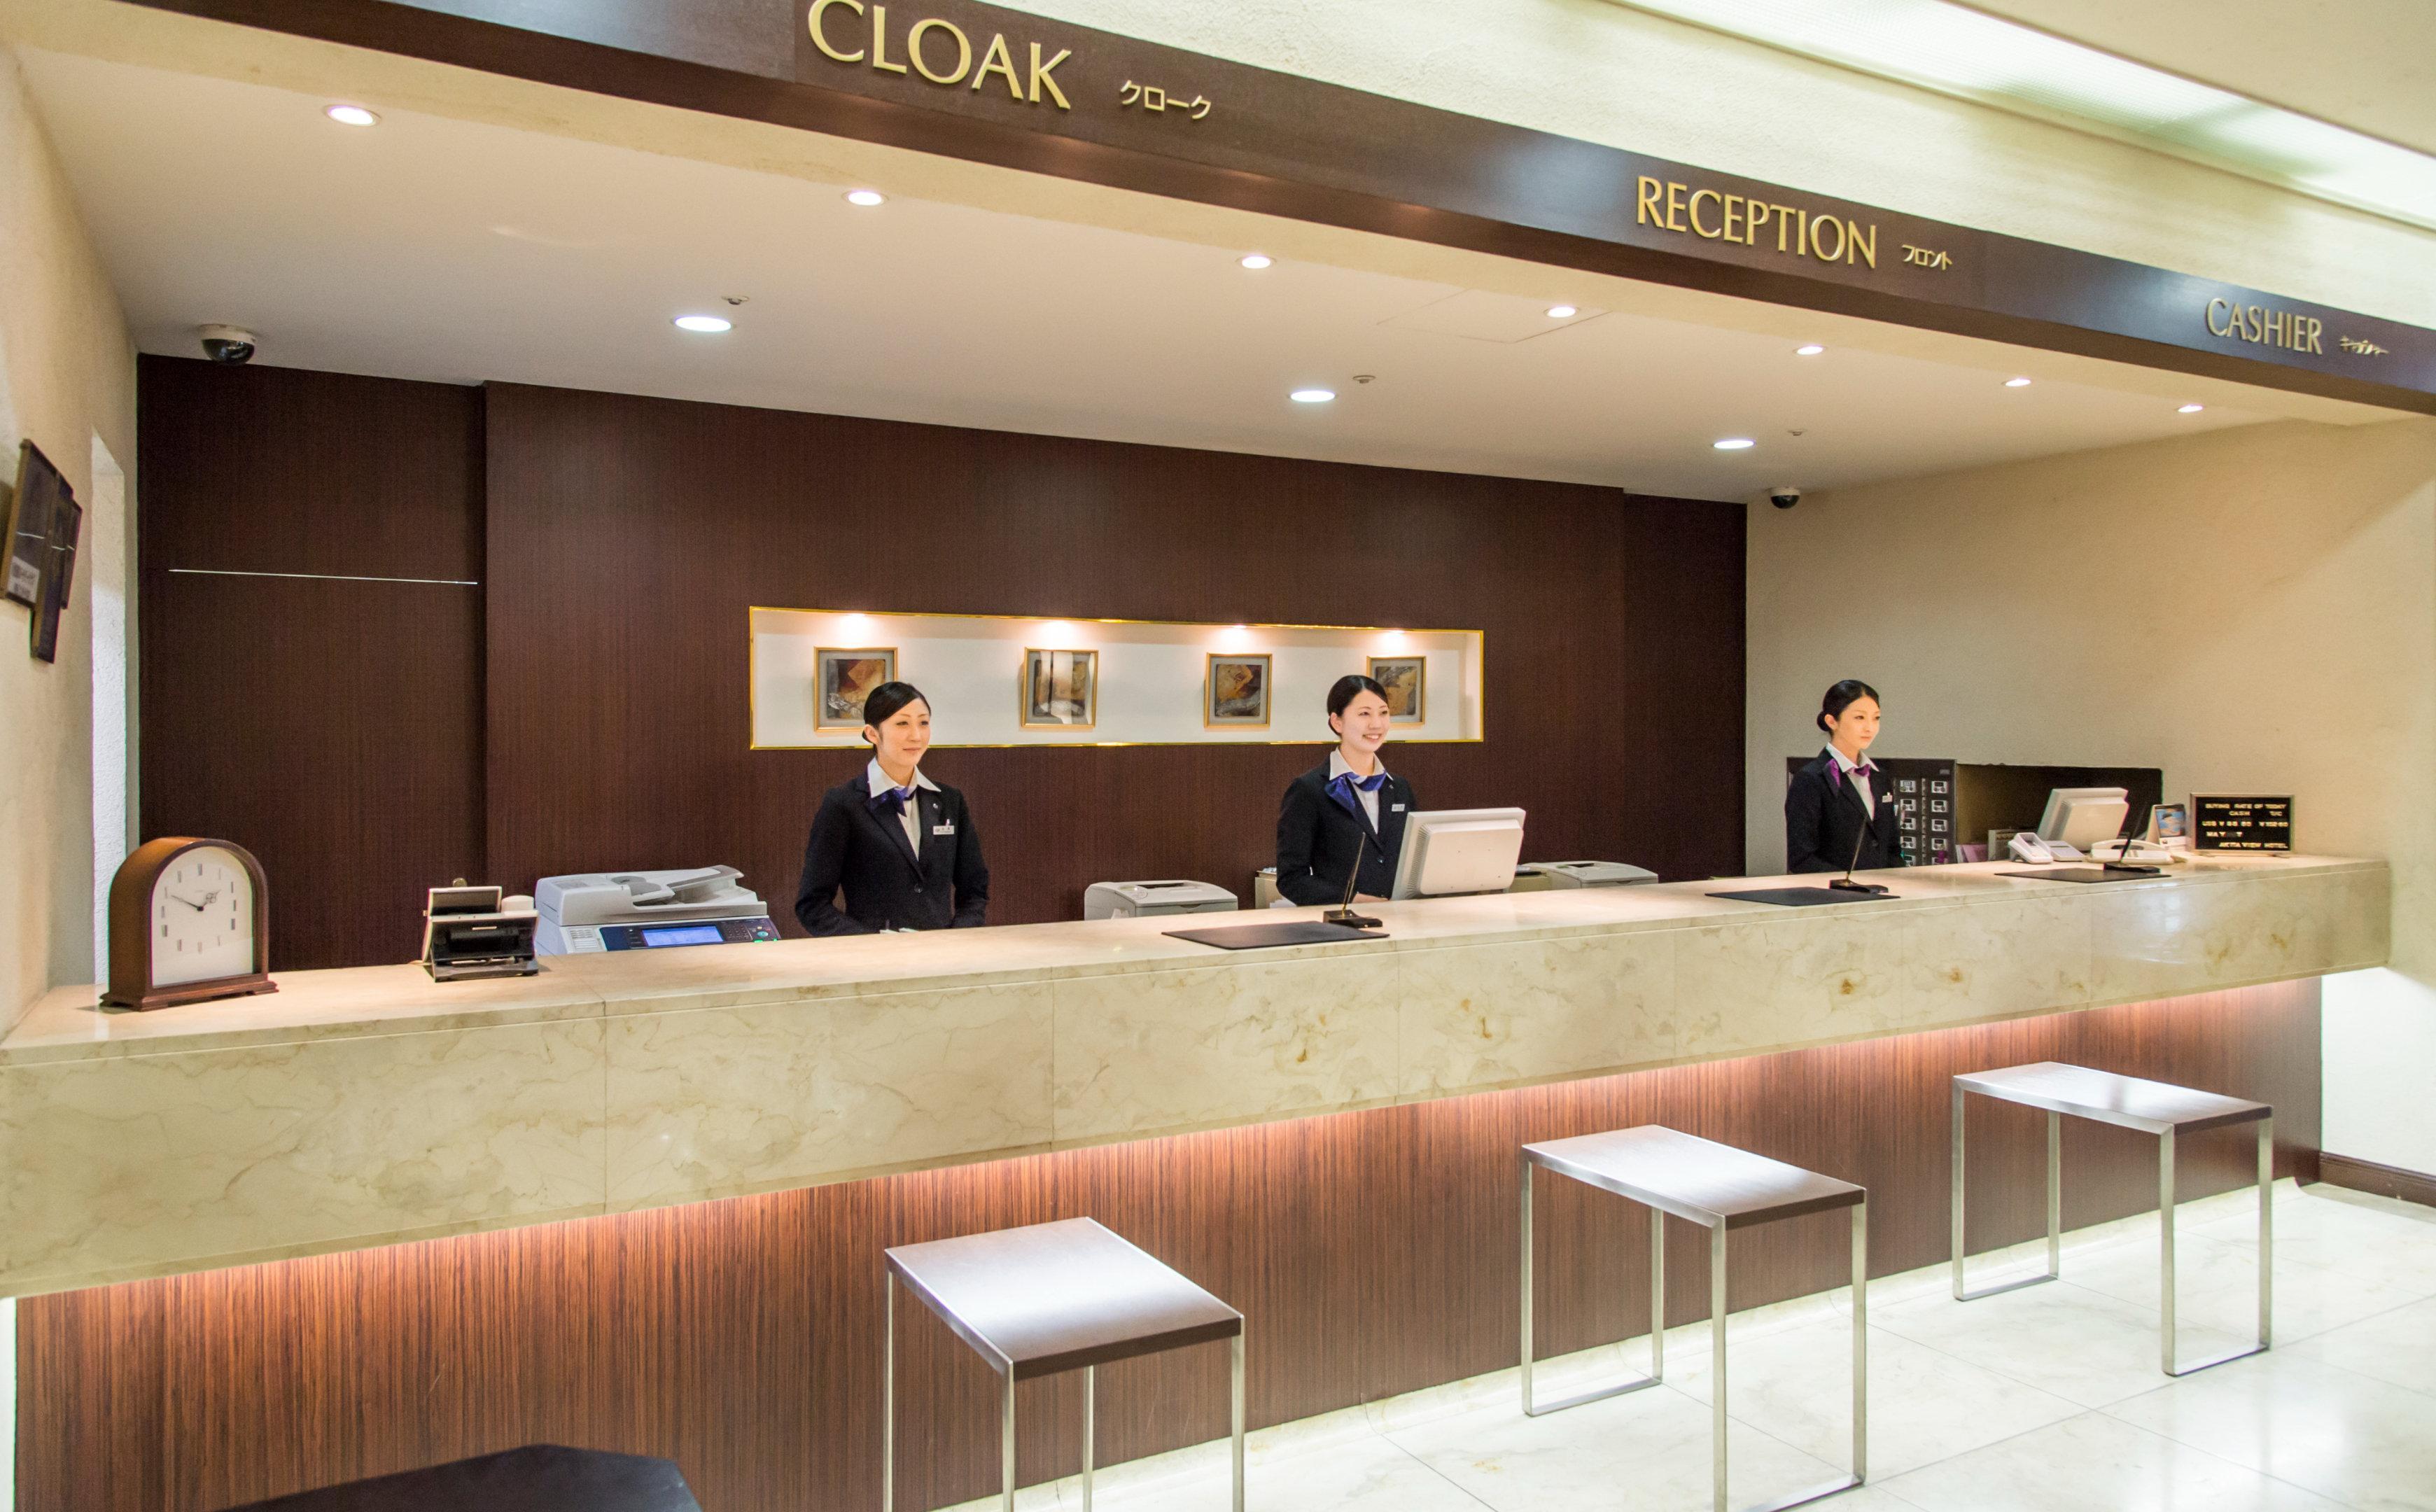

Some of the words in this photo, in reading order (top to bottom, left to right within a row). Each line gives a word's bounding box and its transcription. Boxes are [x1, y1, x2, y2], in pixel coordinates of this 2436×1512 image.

[807, 0, 1071, 110] CLOAK
[1121, 80, 1212, 120] クローク
[1637, 176, 1877, 269] RECEPTION
[1902, 244, 1953, 270] フロント
[2206, 298, 2323, 355] CASHIER
